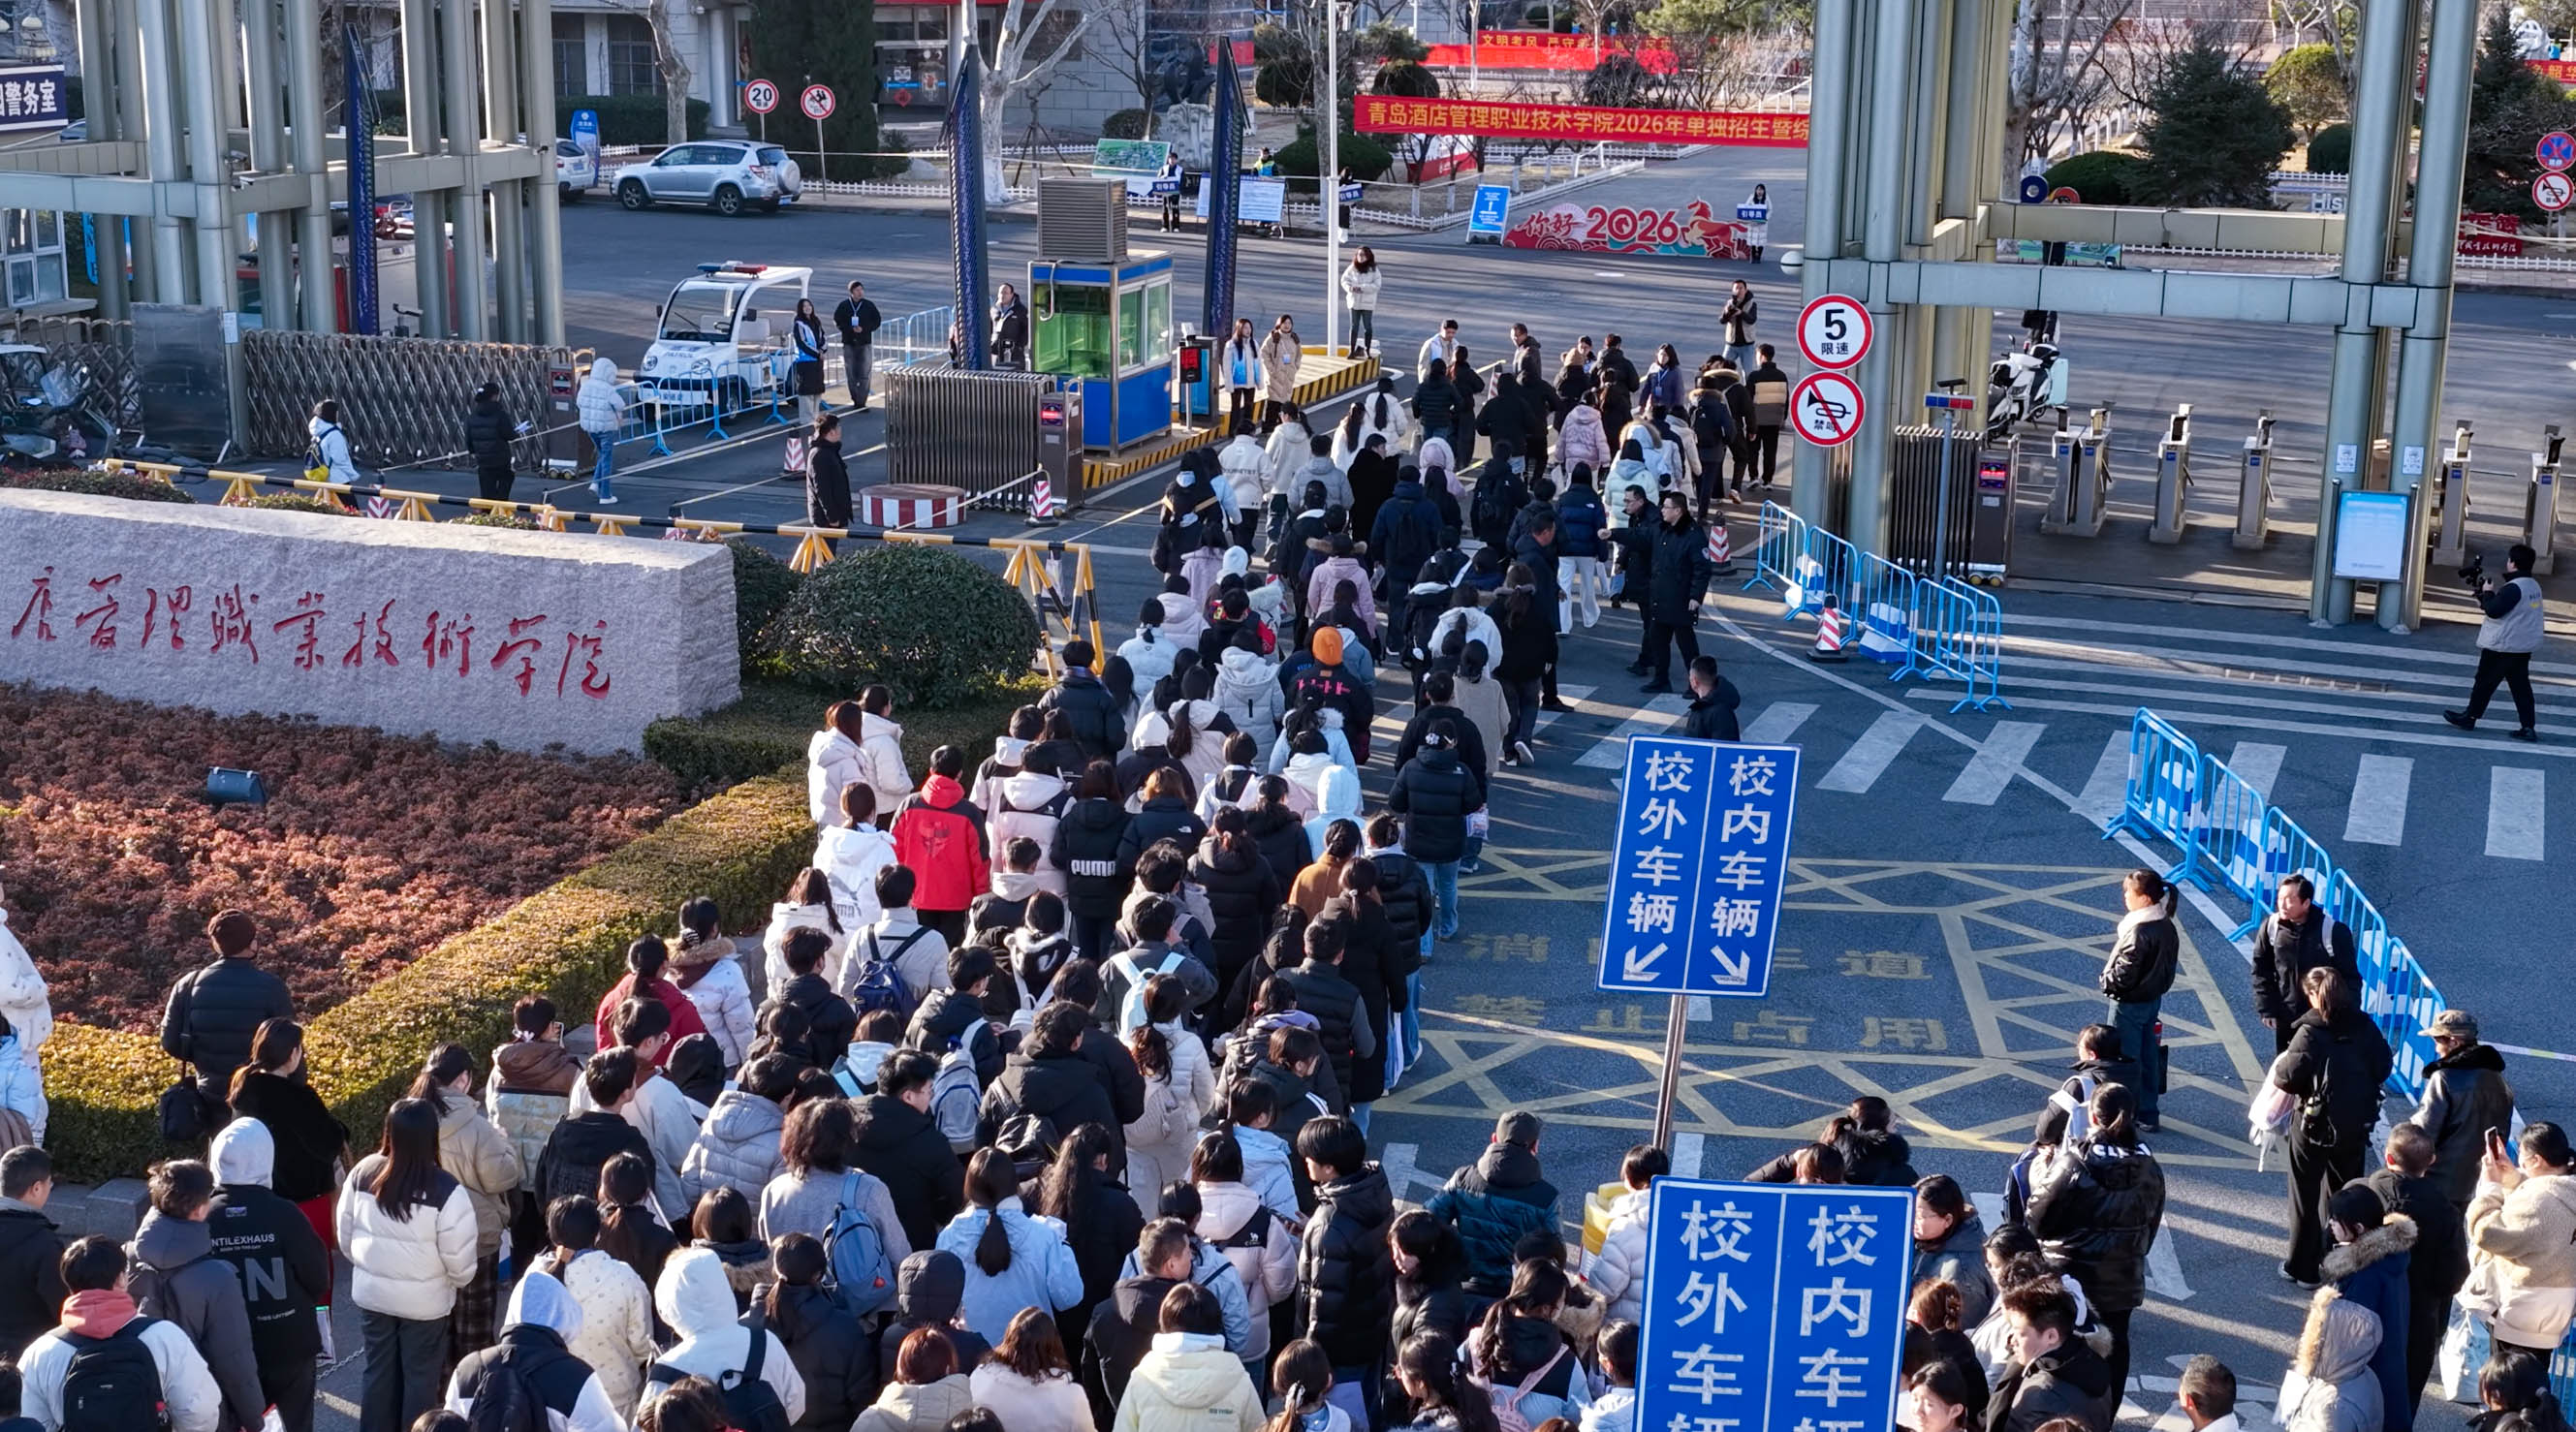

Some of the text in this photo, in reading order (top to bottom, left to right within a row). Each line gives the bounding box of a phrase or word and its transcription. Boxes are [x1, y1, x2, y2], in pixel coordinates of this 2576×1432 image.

[1483, 34, 1538, 47] 文明考风
[752, 88, 772, 102] 20
[1367, 102, 1810, 140] 青岛酒店管理职业技术学院2026年单独招生暨综
[1516, 205, 1680, 242] 你好 2026
[1825, 308, 1847, 341] 5
[1822, 342, 1849, 356] 限速
[1626, 750, 1694, 934] 校外车辆
[1710, 755, 1776, 938] 校内车辆
[1071, 859, 1116, 877] PUMA
[1793, 1205, 1878, 1432] 校内车
